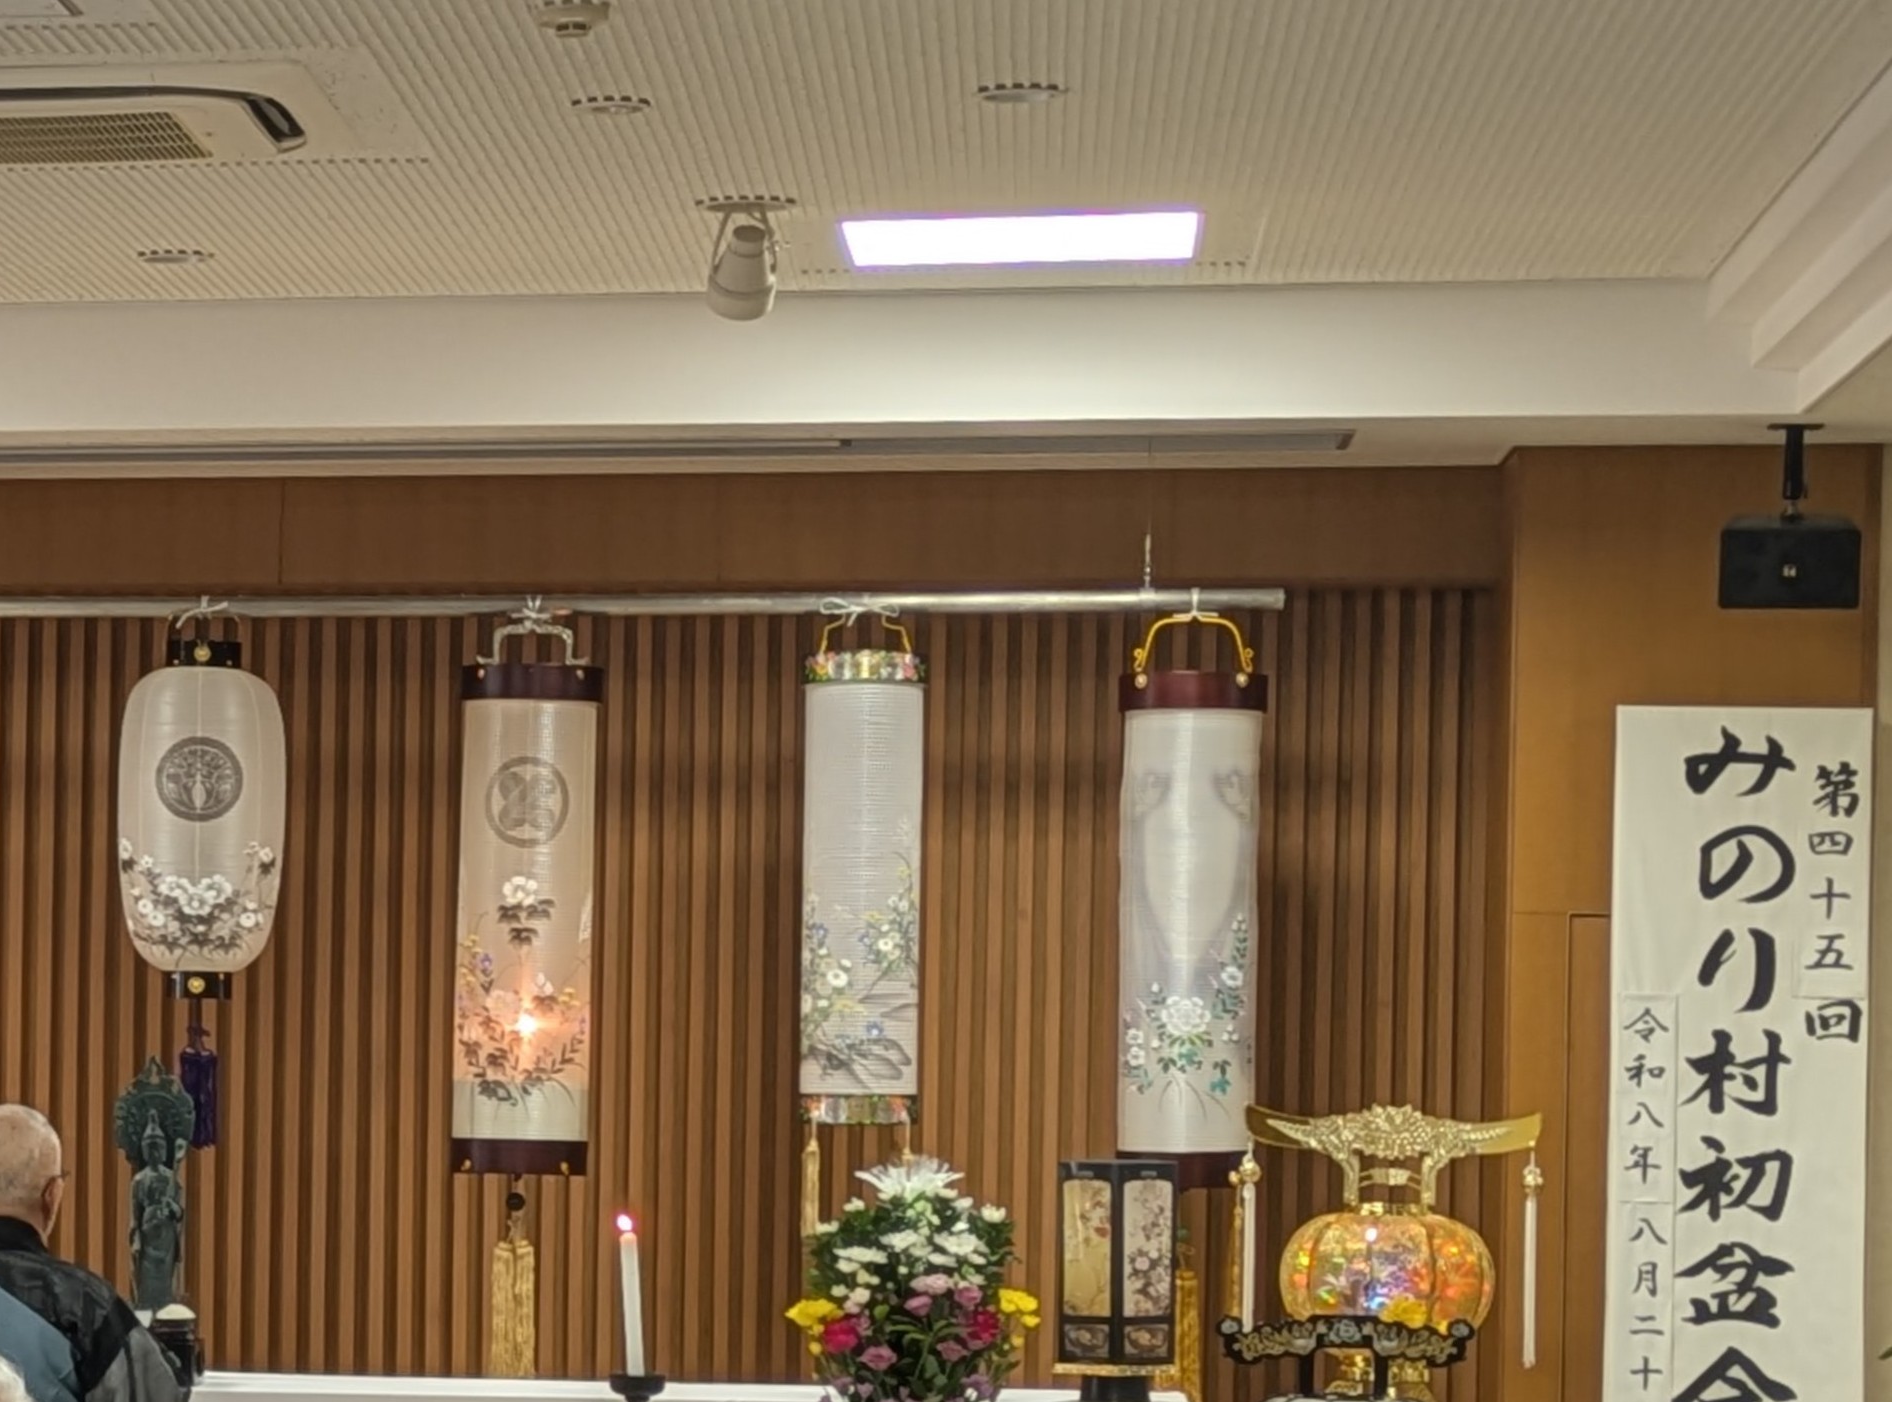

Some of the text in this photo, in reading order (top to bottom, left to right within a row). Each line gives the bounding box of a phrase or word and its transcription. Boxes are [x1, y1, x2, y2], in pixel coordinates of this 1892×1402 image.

[1804, 761, 1863, 1044] 第四十五回
